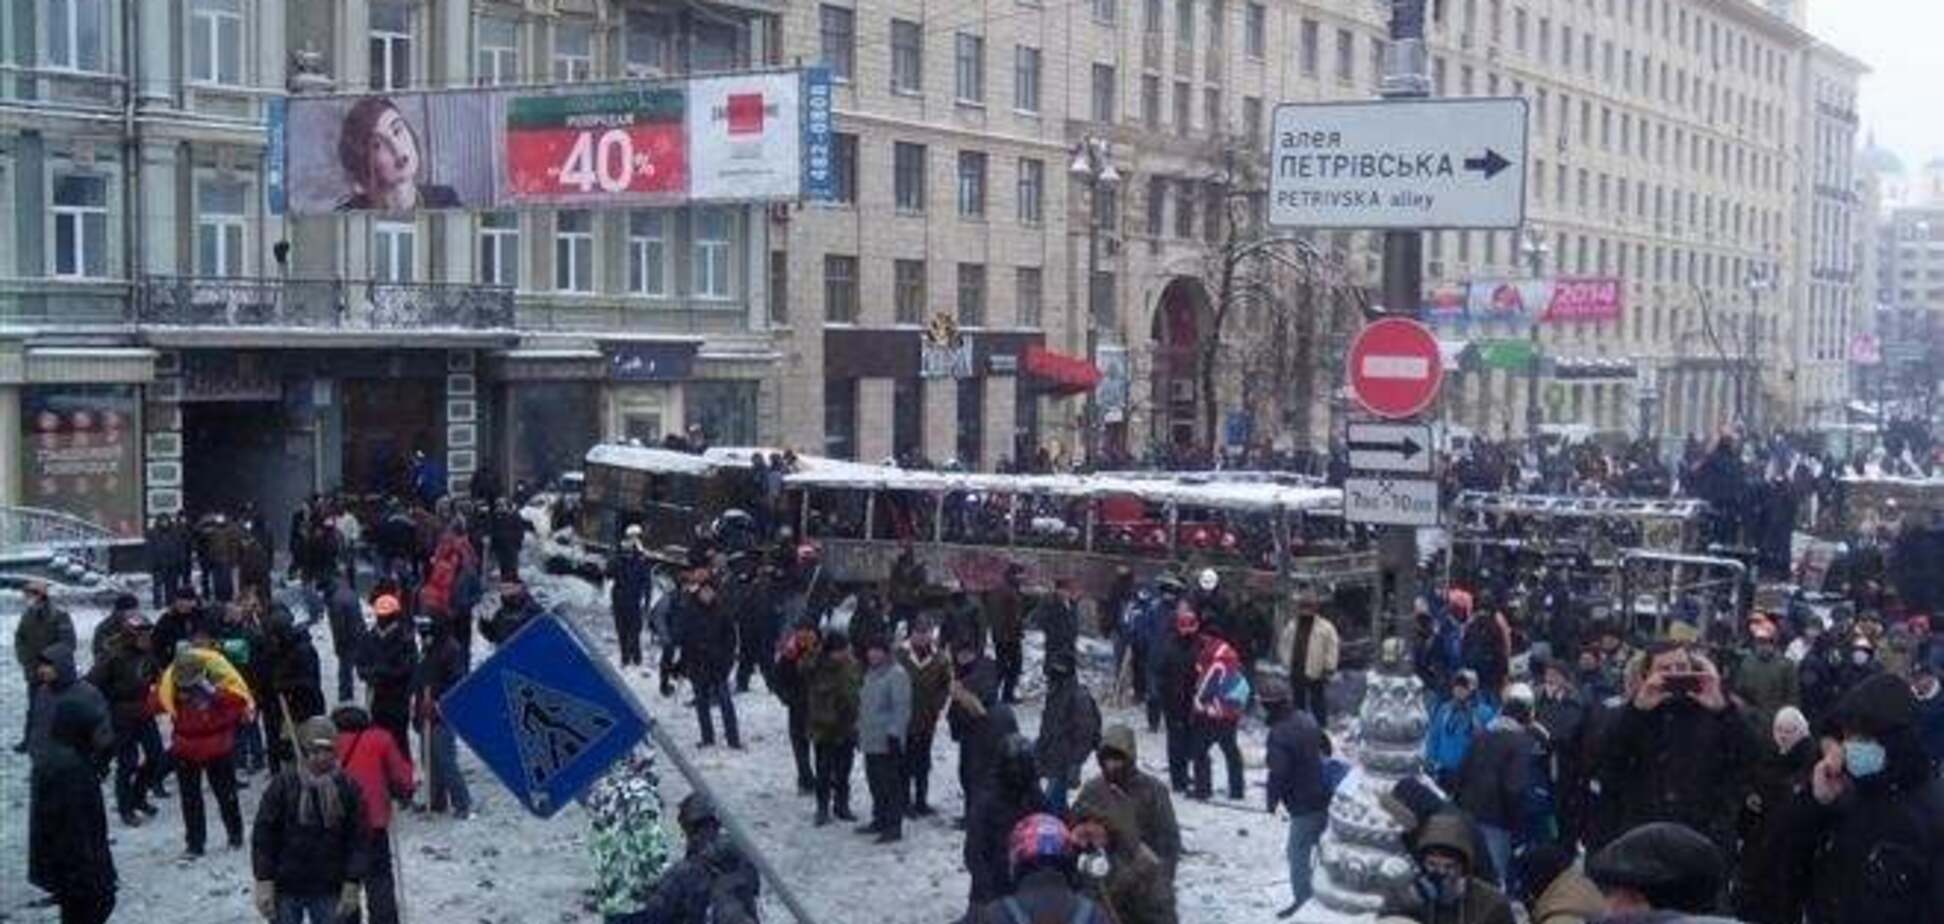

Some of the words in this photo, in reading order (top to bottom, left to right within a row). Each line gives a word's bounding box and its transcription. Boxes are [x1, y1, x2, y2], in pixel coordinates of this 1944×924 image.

[1281, 131, 1341, 148] алея
[1280, 154, 1454, 178] ПЕТРІВСЬКА
[1278, 190, 1380, 207] PETRIVSKA
[1390, 190, 1434, 210] alley
[1556, 281, 1616, 303] 2014
